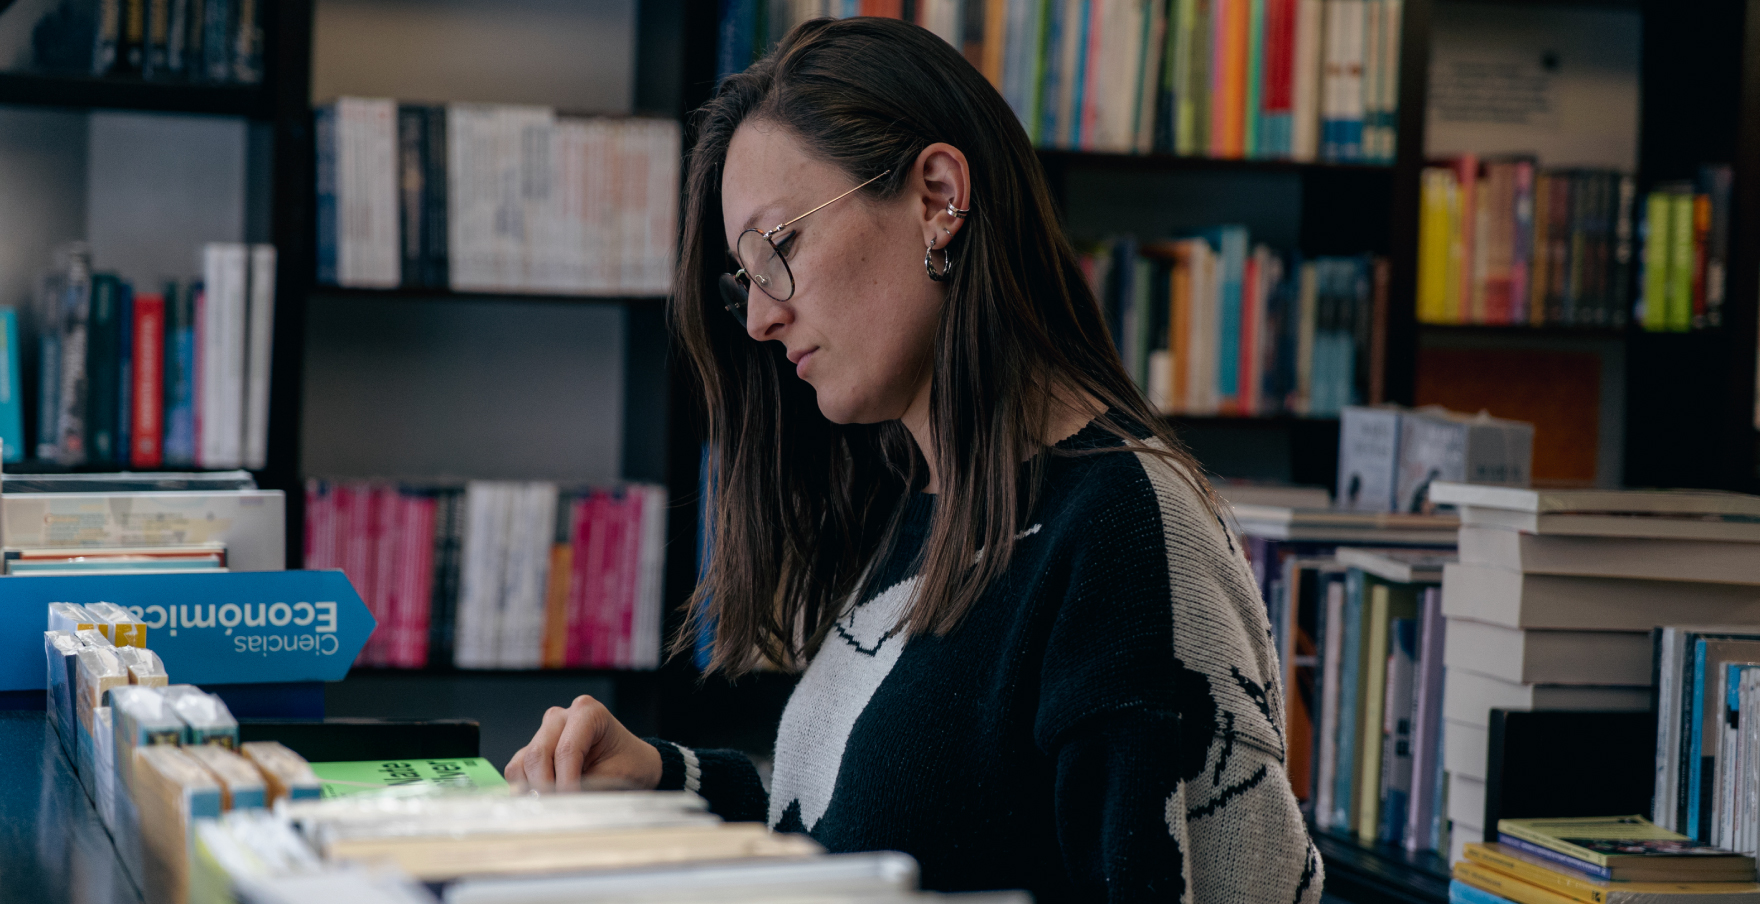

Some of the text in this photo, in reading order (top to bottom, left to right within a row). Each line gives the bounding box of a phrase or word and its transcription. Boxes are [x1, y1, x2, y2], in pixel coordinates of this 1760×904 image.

[121, 601, 337, 637] Económica
[234, 634, 339, 657] Ciencias
[378, 761, 427, 788] Nate
